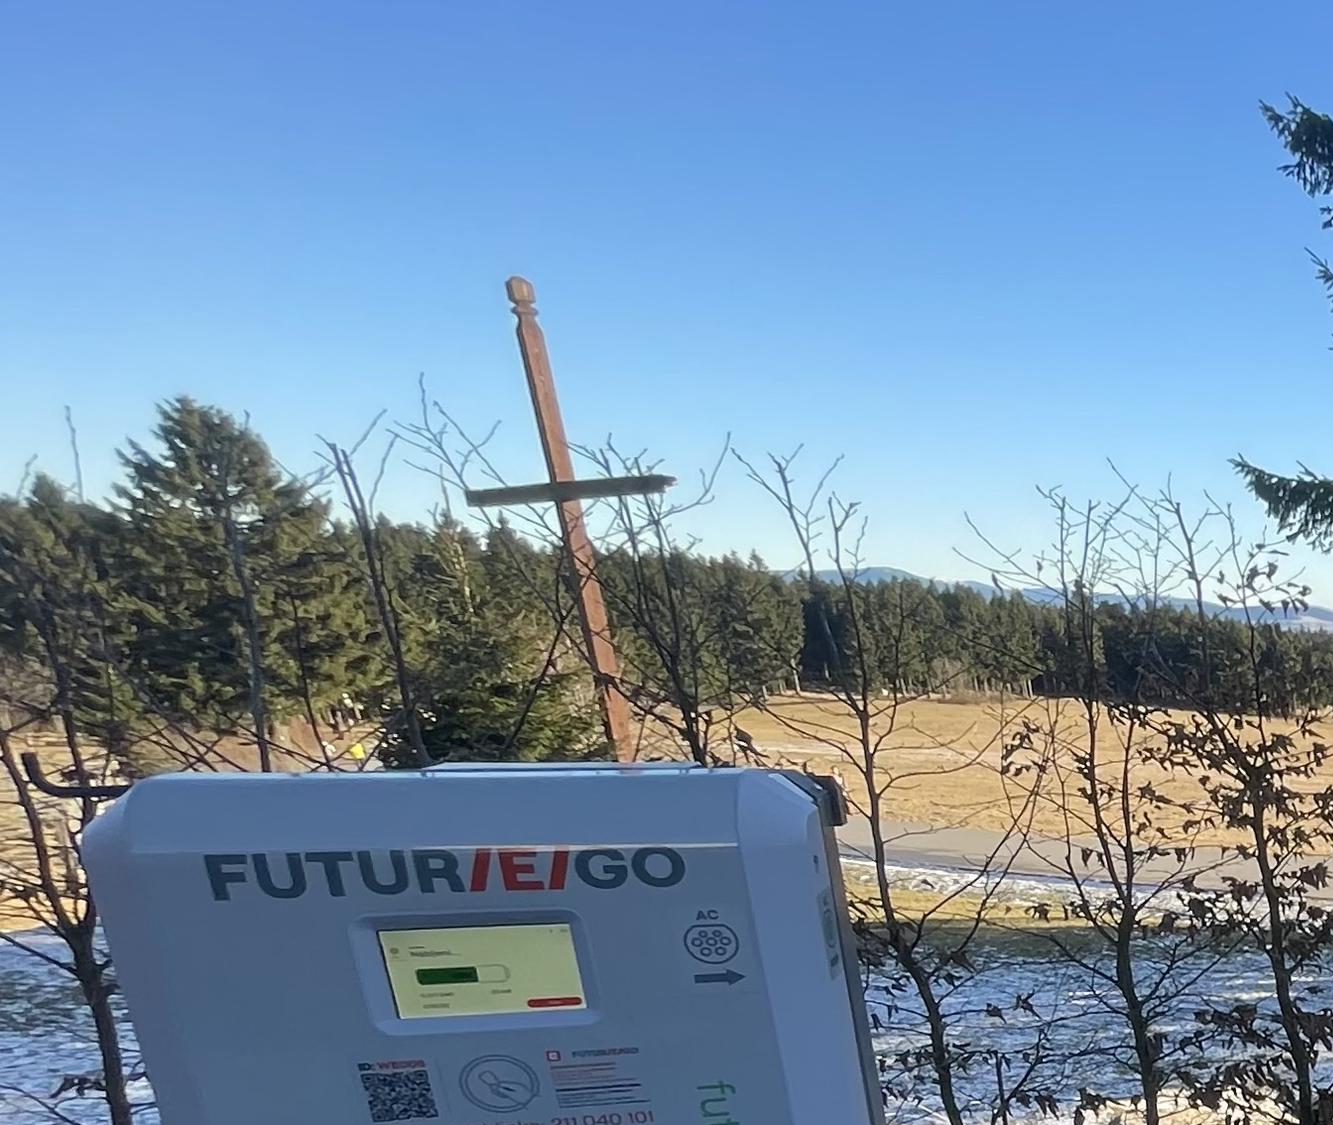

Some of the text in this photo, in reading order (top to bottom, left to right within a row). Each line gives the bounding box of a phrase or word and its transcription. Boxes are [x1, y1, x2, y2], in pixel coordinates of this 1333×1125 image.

[203, 846, 686, 901] FUTUR/E/GO
[696, 909, 720, 921] AC
[627, 1110, 655, 1124] 101
